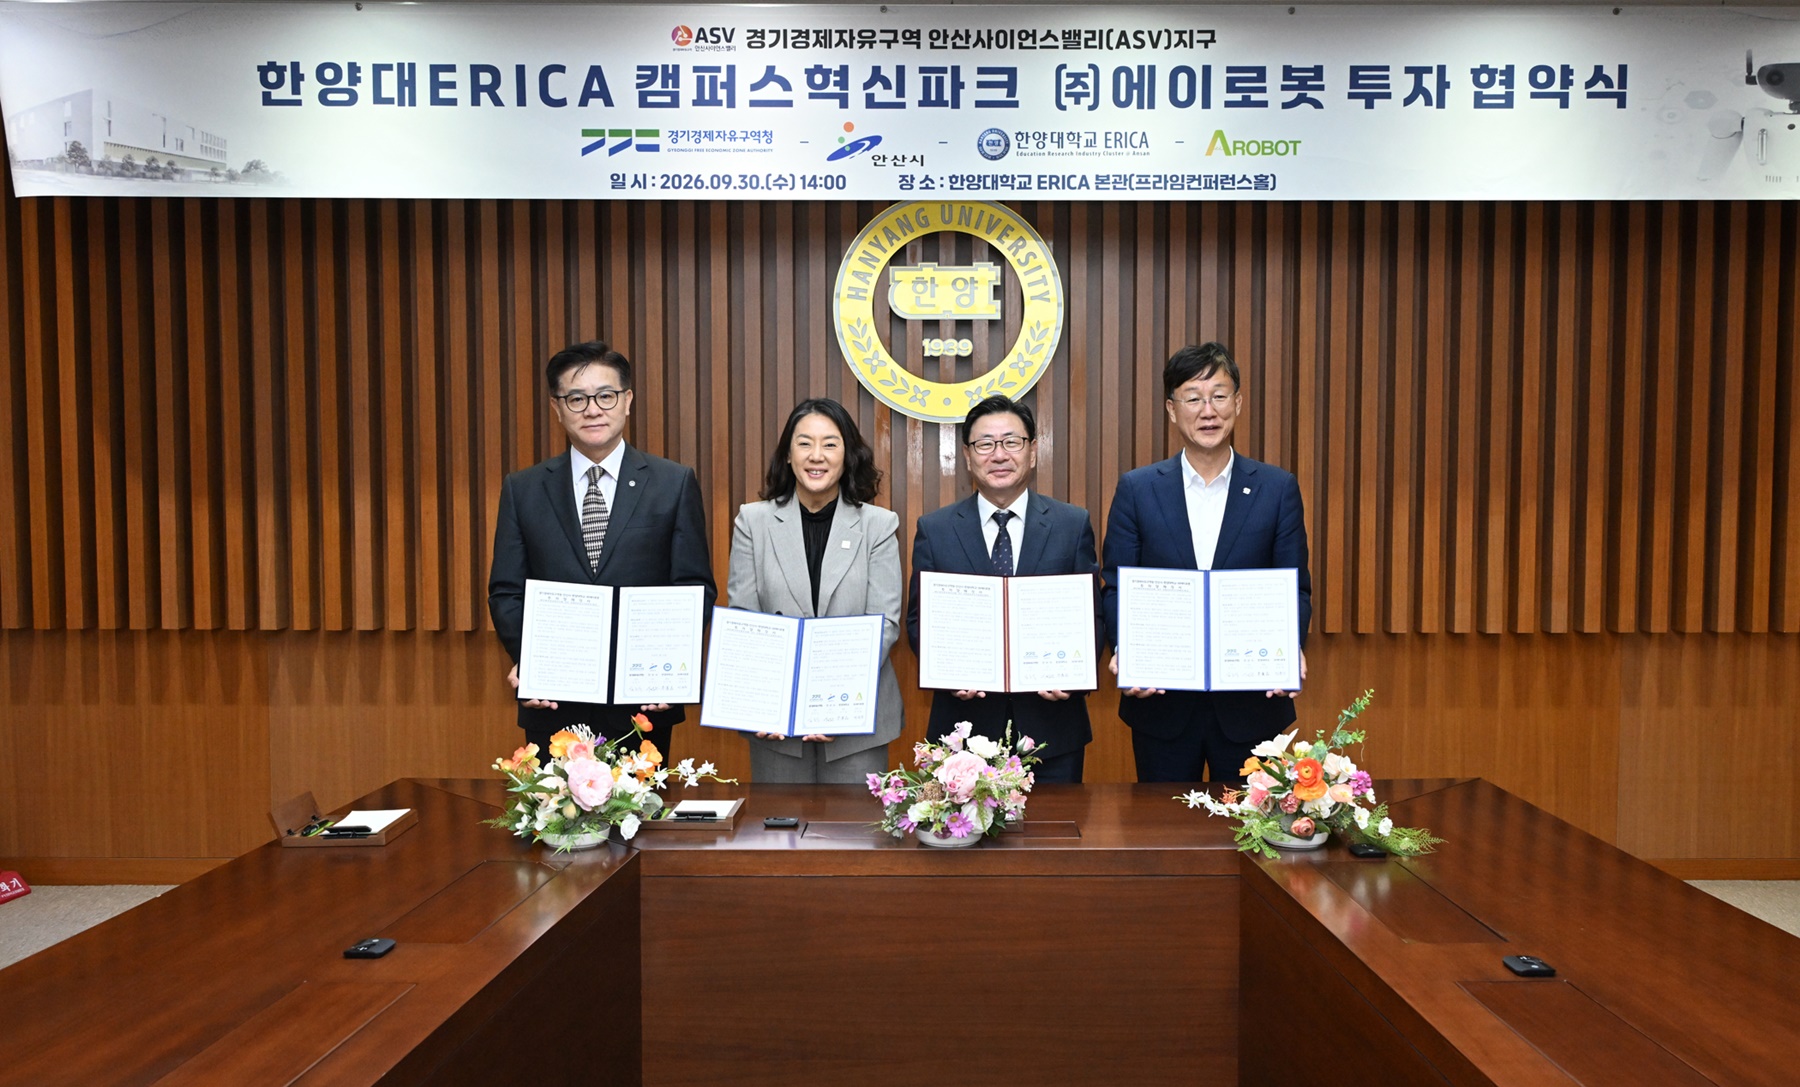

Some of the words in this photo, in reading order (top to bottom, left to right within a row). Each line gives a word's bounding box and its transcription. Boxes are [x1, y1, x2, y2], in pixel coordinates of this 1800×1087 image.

[694, 27, 736, 44] ASV
[745, 28, 922, 50] 경기경제자유구역
[927, 28, 1217, 51] 안산사이언스밸리(ASV)지구
[257, 61, 616, 108] 한양대ERICA
[635, 63, 1020, 110] 캠퍼스혁신파크
[1347, 64, 1451, 110] 투자
[1470, 64, 1629, 110] 협약식
[667, 129, 774, 145] 경기경제자유구역청
[1015, 130, 1098, 150] 한양대학교
[1104, 131, 1150, 149] ERICA
[1205, 129, 1302, 156] AROBOT
[871, 154, 925, 168] 안산시
[1075, 150, 1101, 158] Industry
[660, 173, 796, 191] 2026.09.30.(수)
[800, 174, 847, 190] 14:00
[948, 173, 1032, 191] 한양대학교
[1037, 174, 1090, 190] ERICA
[1094, 173, 1277, 191] 본관(프라임컨퍼런스홀)
[847, 206, 930, 301] HANYANG
[940, 203, 1051, 303] UNIVERSITY
[922, 338, 974, 357] 1939
